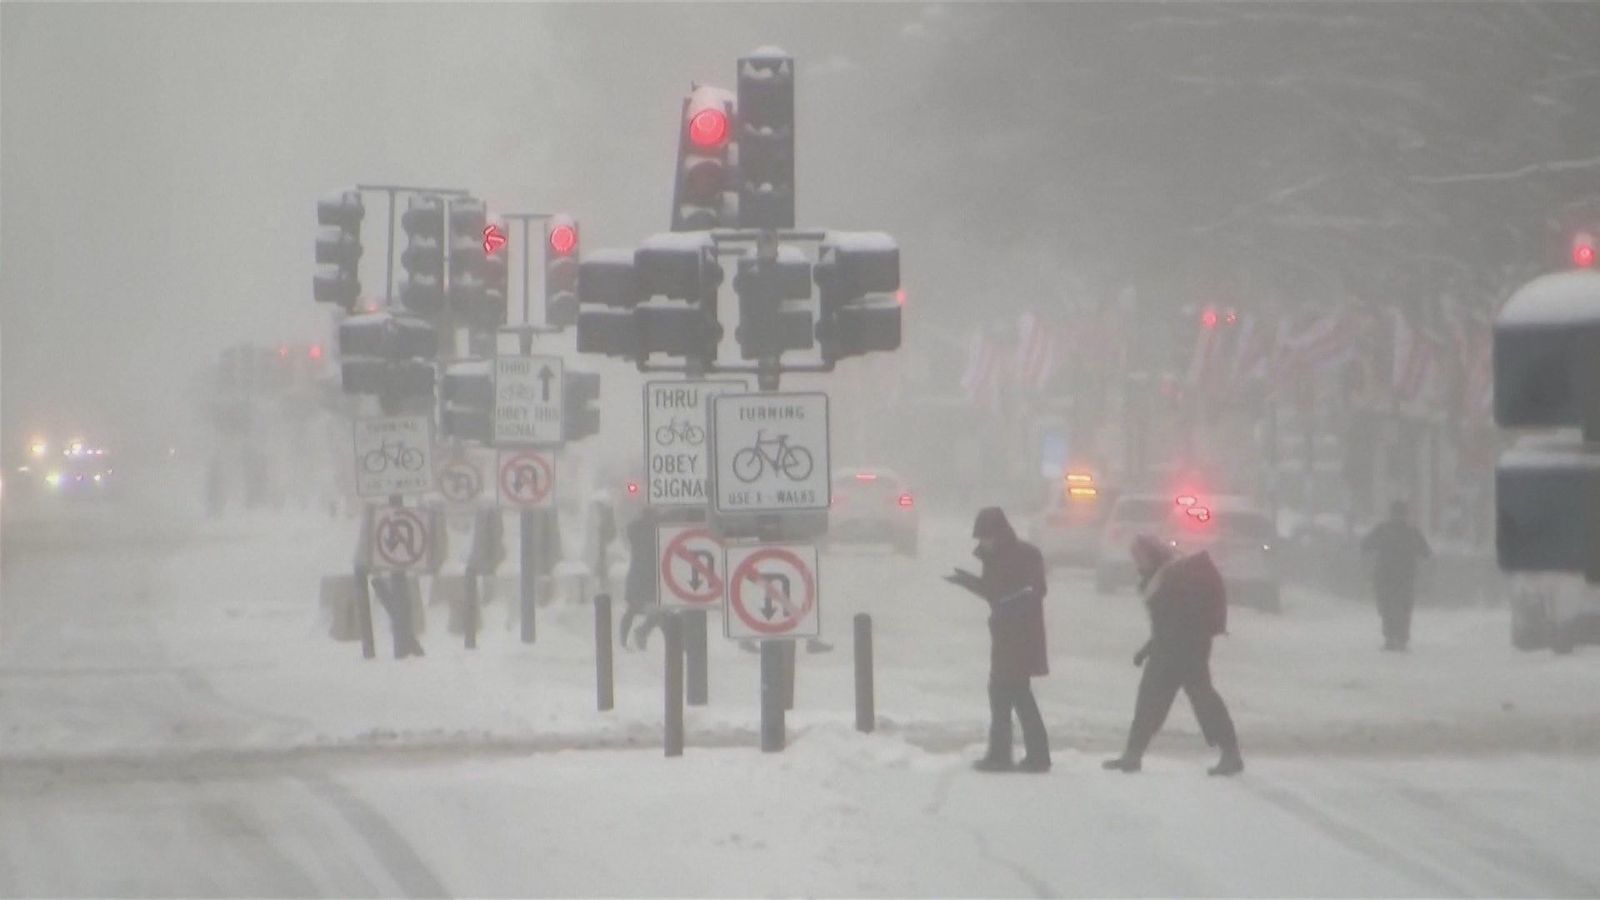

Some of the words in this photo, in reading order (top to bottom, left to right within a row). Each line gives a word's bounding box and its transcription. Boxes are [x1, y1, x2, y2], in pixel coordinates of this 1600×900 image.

[655, 389, 698, 408] THRU
[739, 406, 804, 420] TURNING
[652, 454, 698, 474] OBEY
[728, 491, 751, 505] USE
